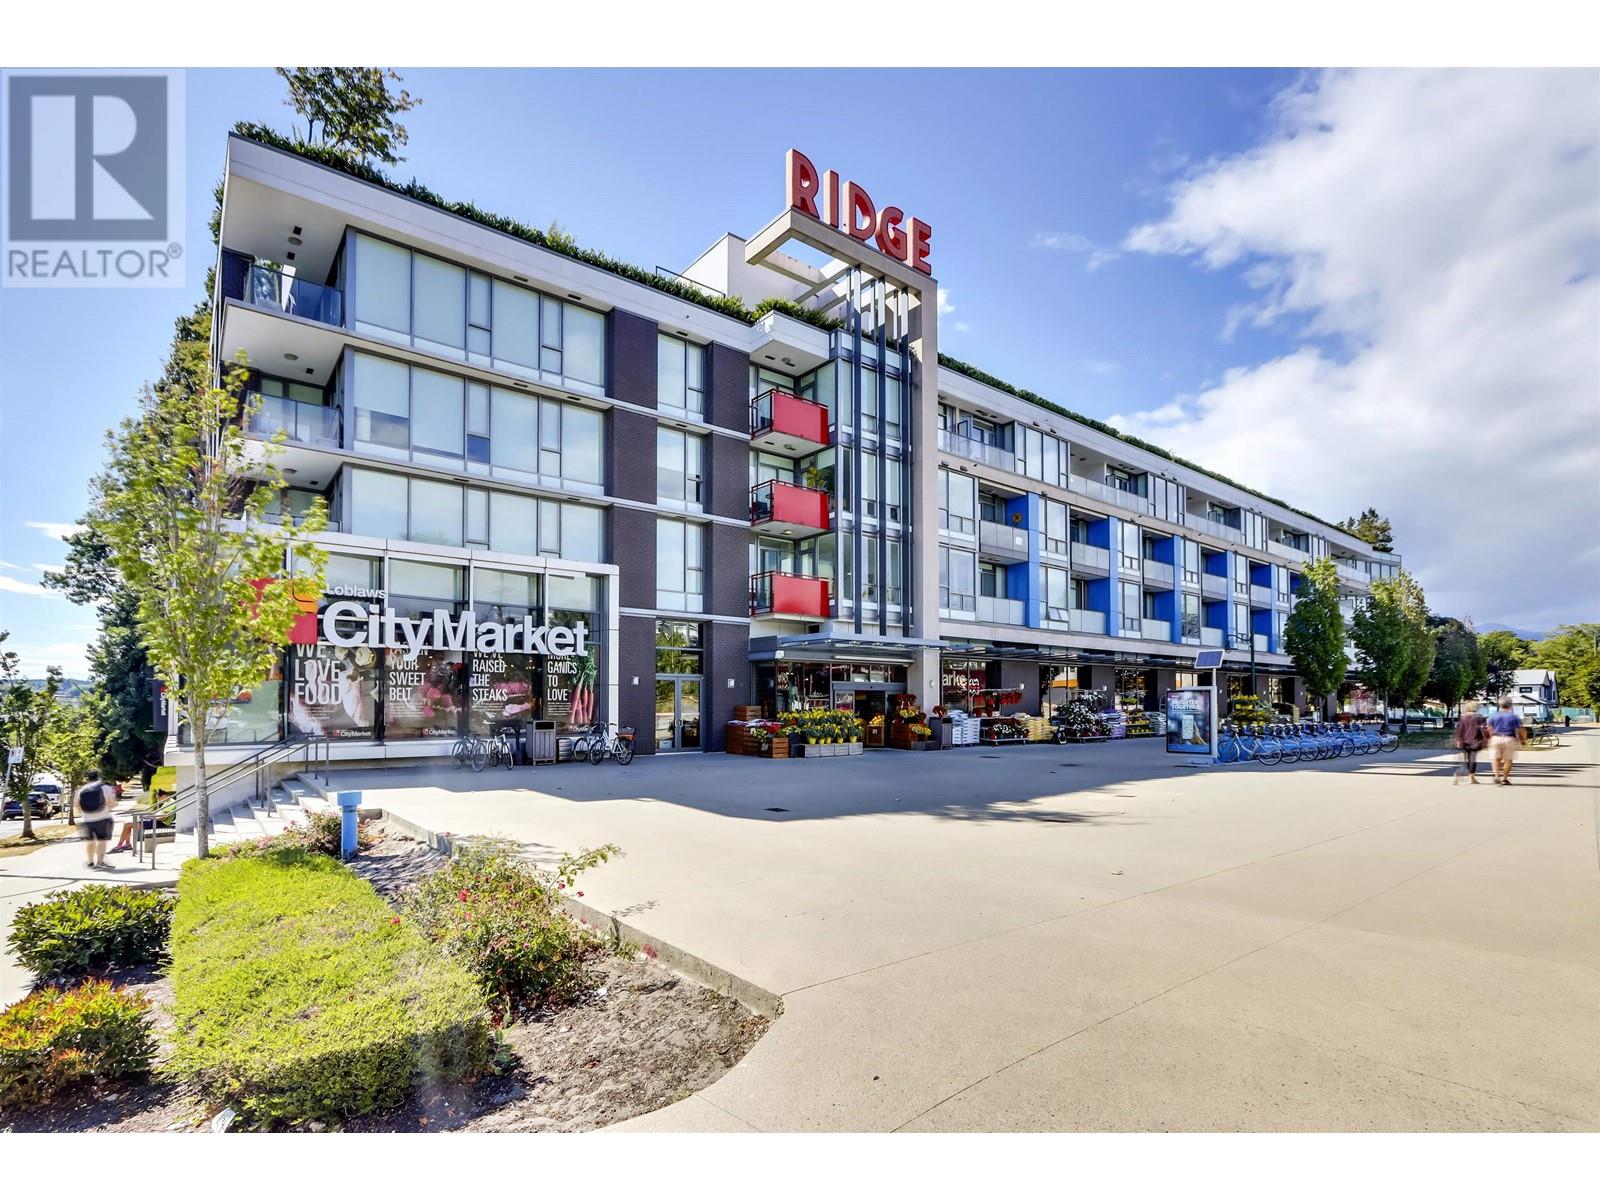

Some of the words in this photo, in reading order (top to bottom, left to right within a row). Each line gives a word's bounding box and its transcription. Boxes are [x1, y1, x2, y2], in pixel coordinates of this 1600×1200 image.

[786, 149, 932, 275] RIDGE
[325, 583, 387, 599] Loblaws
[323, 601, 589, 661] CityMarket
[296, 643, 327, 658] WE
[295, 659, 341, 681] LOVE
[473, 660, 506, 672] RAISED
[547, 661, 577, 674] GANICS
[389, 672, 426, 685] SWEET
[472, 674, 490, 687] THE
[547, 675, 558, 687] TO
[295, 683, 342, 705] FOOD
[389, 687, 412, 701] BELT
[472, 688, 507, 701] STEAKS
[547, 689, 568, 701] LOVE
